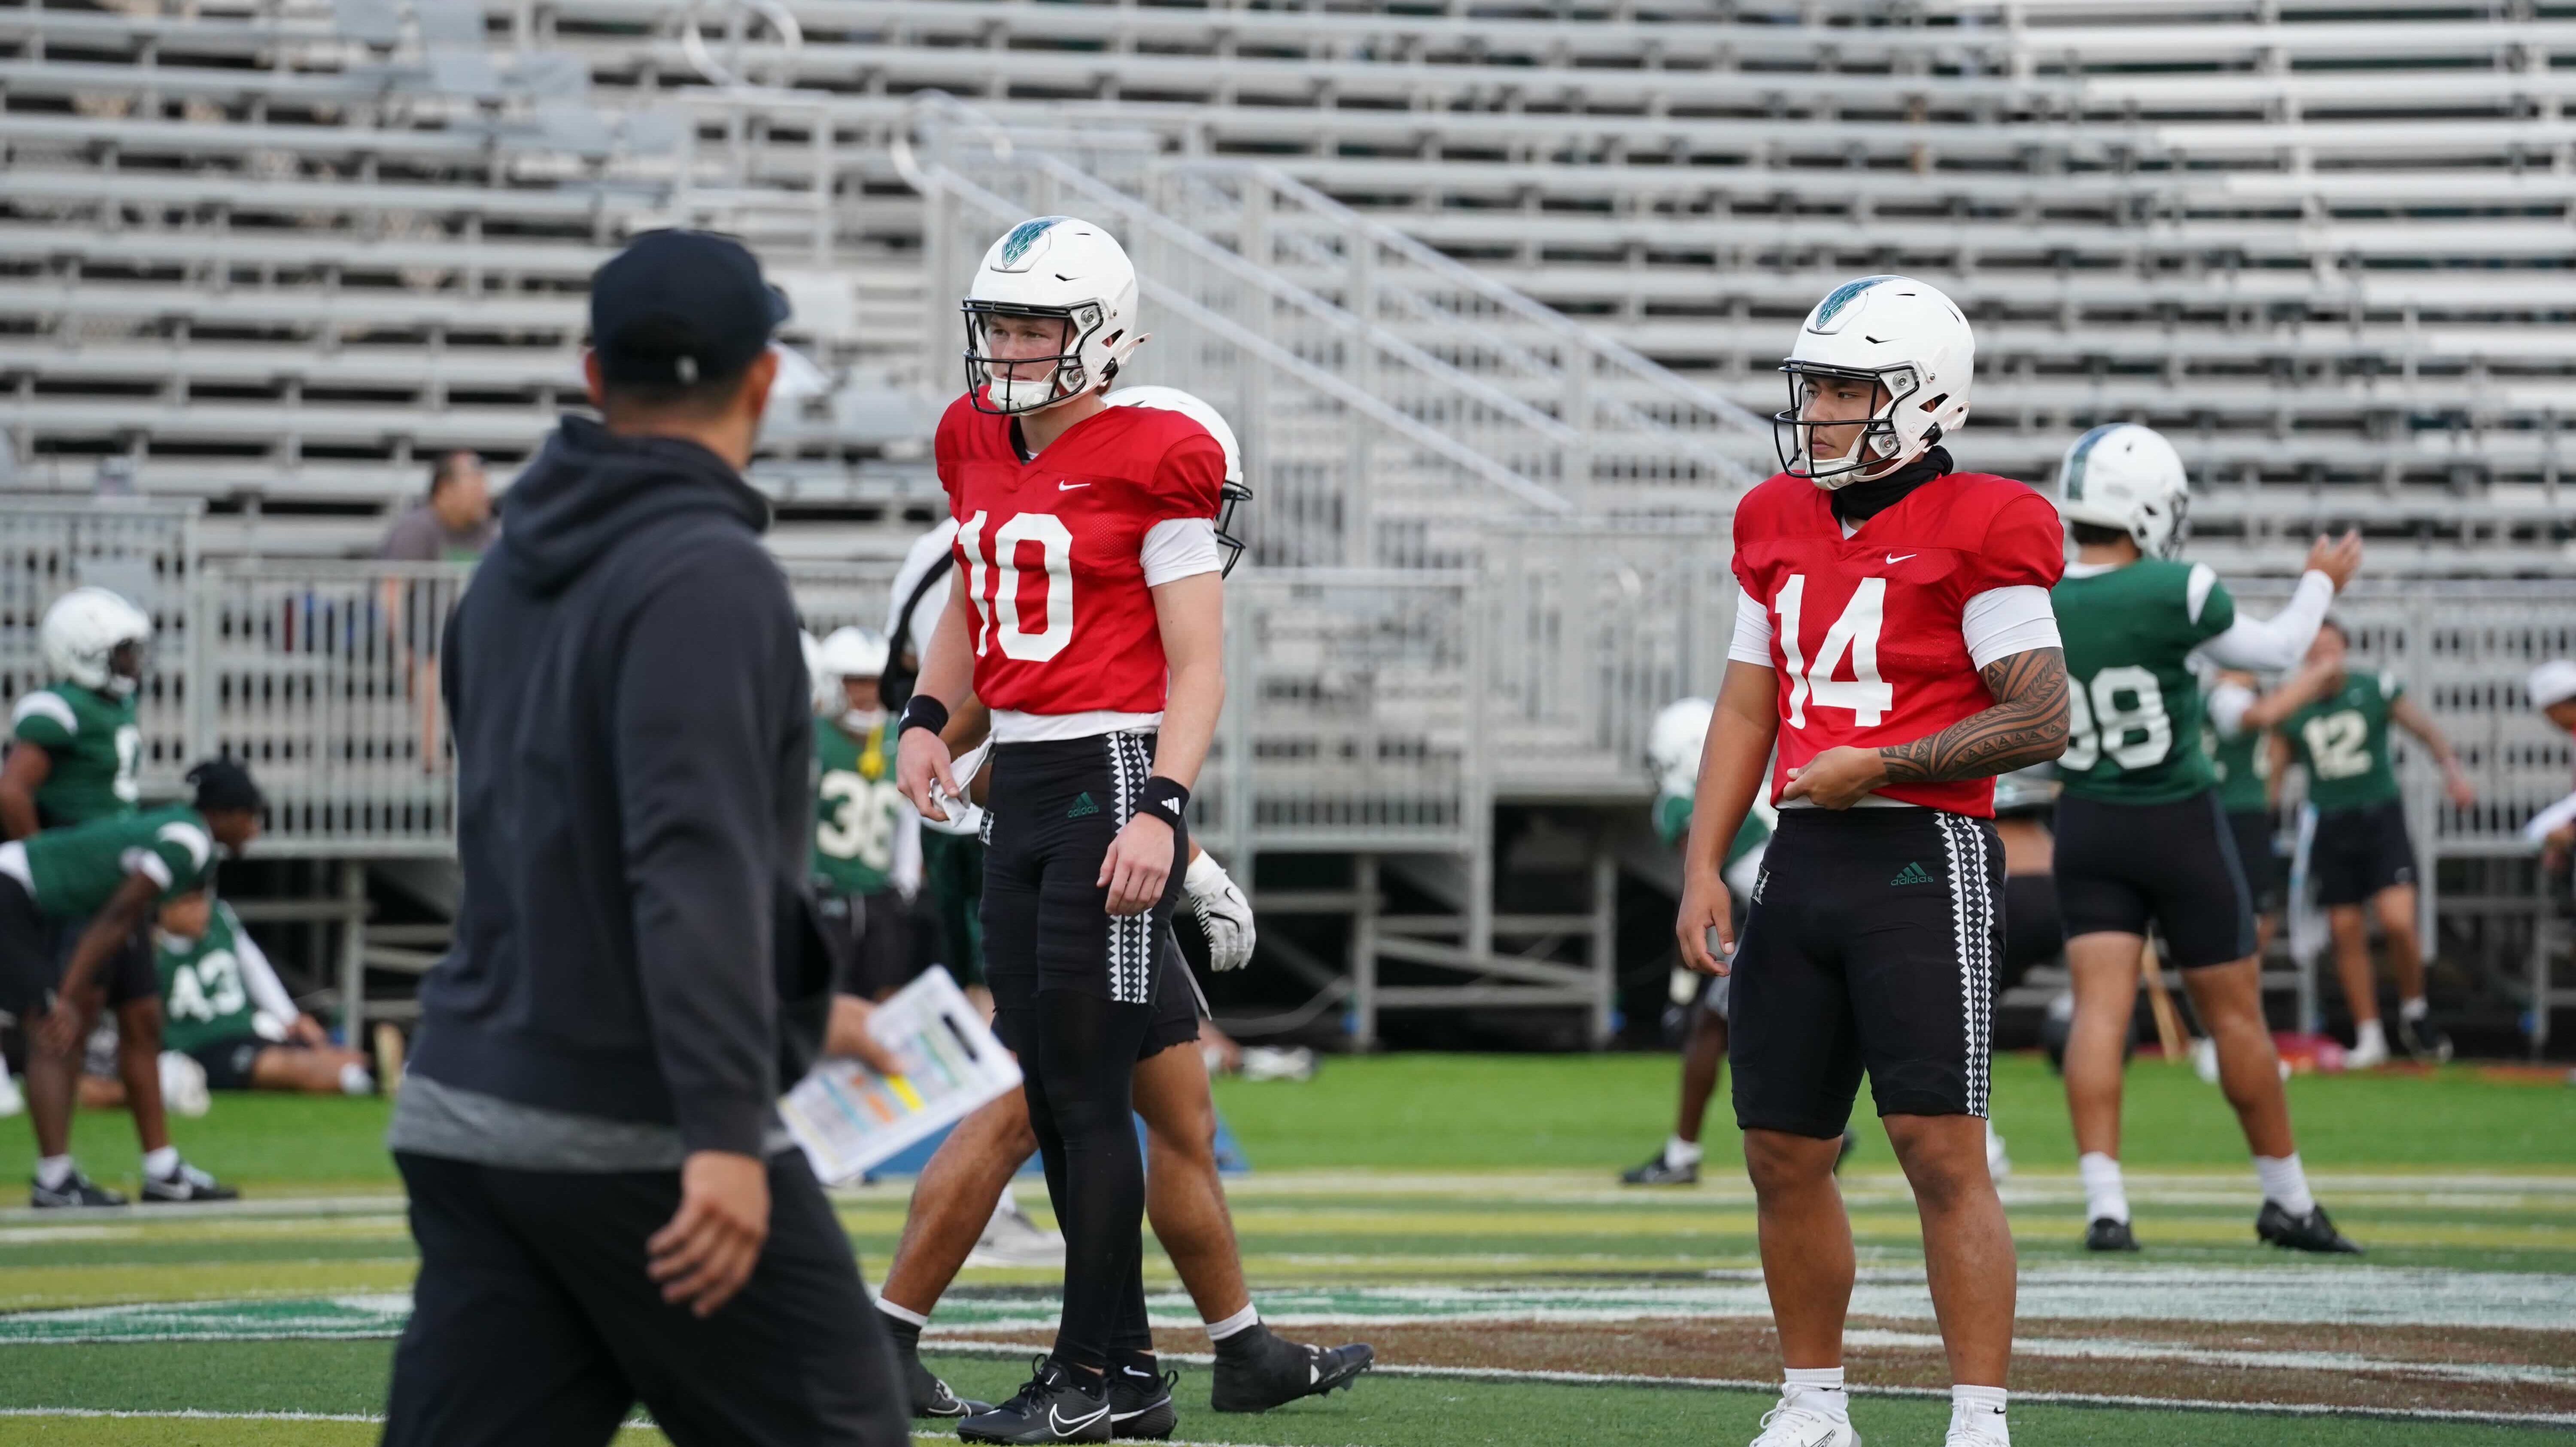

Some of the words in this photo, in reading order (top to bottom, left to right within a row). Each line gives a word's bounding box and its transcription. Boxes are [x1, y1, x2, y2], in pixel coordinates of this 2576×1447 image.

[958, 510, 1073, 662] 10
[1775, 574, 1893, 729] 14
[2303, 709, 2372, 781] 12
[1068, 804, 1100, 818] adidas
[1890, 875, 1934, 886] adidas
[168, 948, 246, 1023] 43
